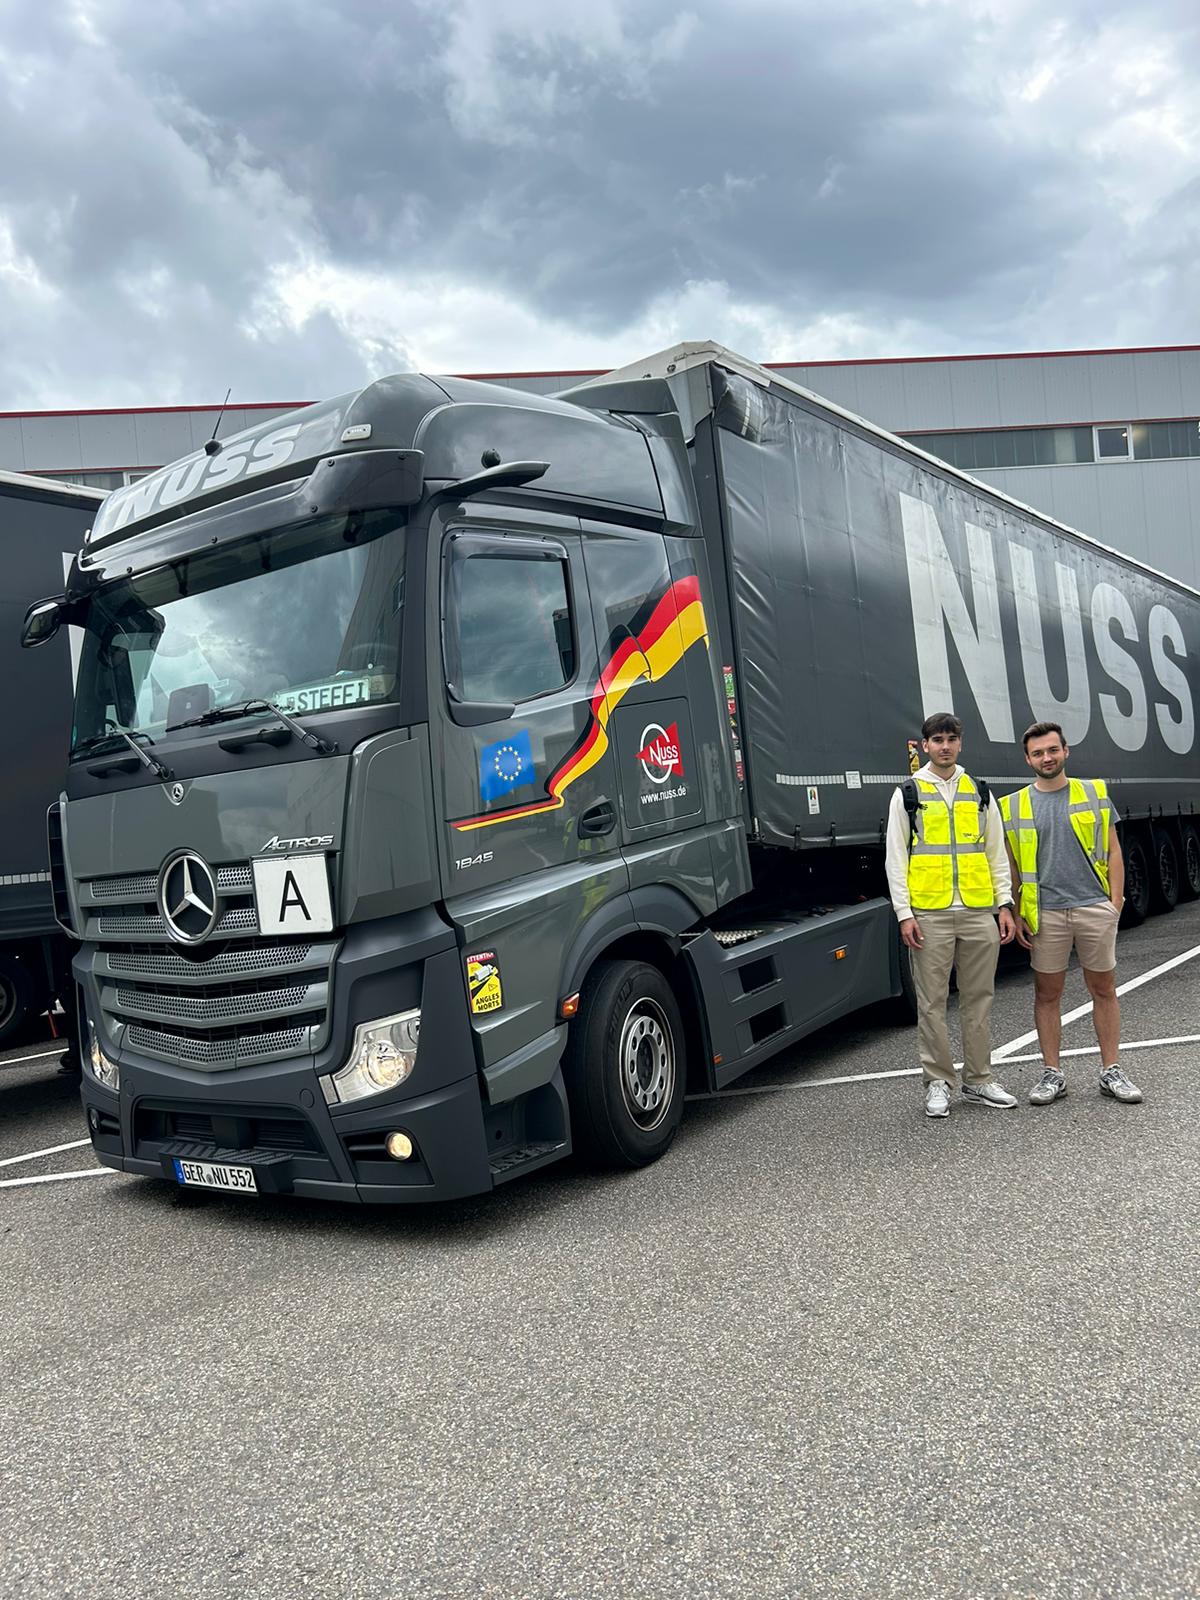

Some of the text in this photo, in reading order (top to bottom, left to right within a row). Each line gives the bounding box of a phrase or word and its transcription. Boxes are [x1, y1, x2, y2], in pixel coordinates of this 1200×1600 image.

[112, 422, 303, 530] NUSS
[899, 491, 1195, 755] NUSS
[297, 682, 366, 712] STEFFI
[640, 785, 687, 805] www.nuss.de
[260, 834, 334, 852] ACTROS
[455, 851, 494, 870] 1845
[279, 870, 312, 922] A
[476, 993, 499, 1005] ANGLES
[478, 1000, 499, 1011] MORTS
[182, 1163, 255, 1188] GER NU 552
